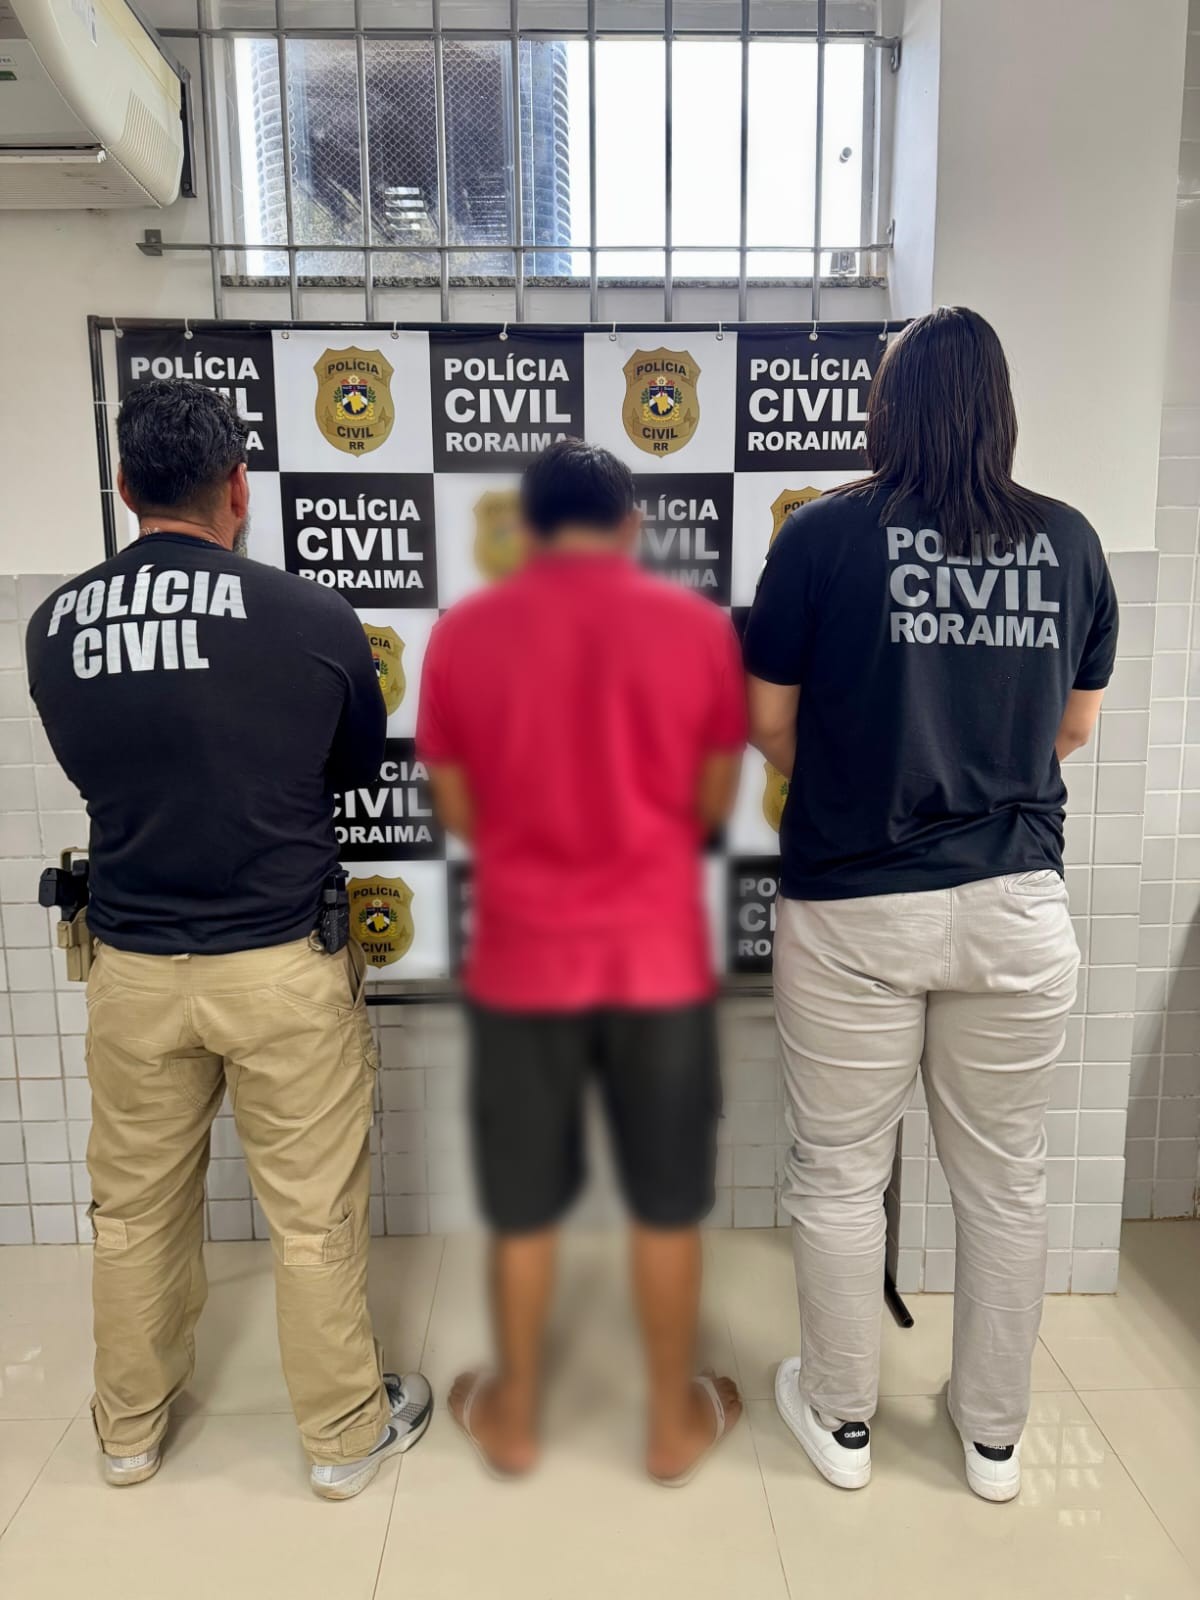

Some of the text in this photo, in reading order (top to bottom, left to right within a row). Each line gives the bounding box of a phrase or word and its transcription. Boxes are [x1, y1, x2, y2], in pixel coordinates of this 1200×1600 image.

[130, 351, 260, 381] POLÍCIA
[327, 359, 380, 375] POLÍCIA
[444, 352, 570, 381] POLÍCIA
[636, 360, 687, 376] POLÍCIA
[750, 352, 872, 381] POLÍCIA
[445, 387, 571, 423] CIVIL
[749, 387, 870, 423] CIVIL
[336, 426, 374, 438] CIVIL
[348, 441, 365, 450] RR
[642, 427, 678, 440] CIVIL
[748, 431, 868, 451] RORAIMA
[653, 442, 669, 451] RR
[295, 493, 421, 521] POLÍCIA
[633, 494, 719, 521] LÍCIA
[297, 527, 424, 561] CIVIL
[636, 527, 720, 560] VIL
[47, 564, 248, 637] POLÍCIA
[890, 563, 1060, 613] CIVIL
[890, 611, 1060, 649] RORAIMA
[72, 619, 210, 680] CIVIL
[334, 825, 433, 844] ORAIMA
[353, 885, 401, 899] POLÍCIA
[361, 942, 395, 953] CIVIL
[371, 954, 387, 963] RR
